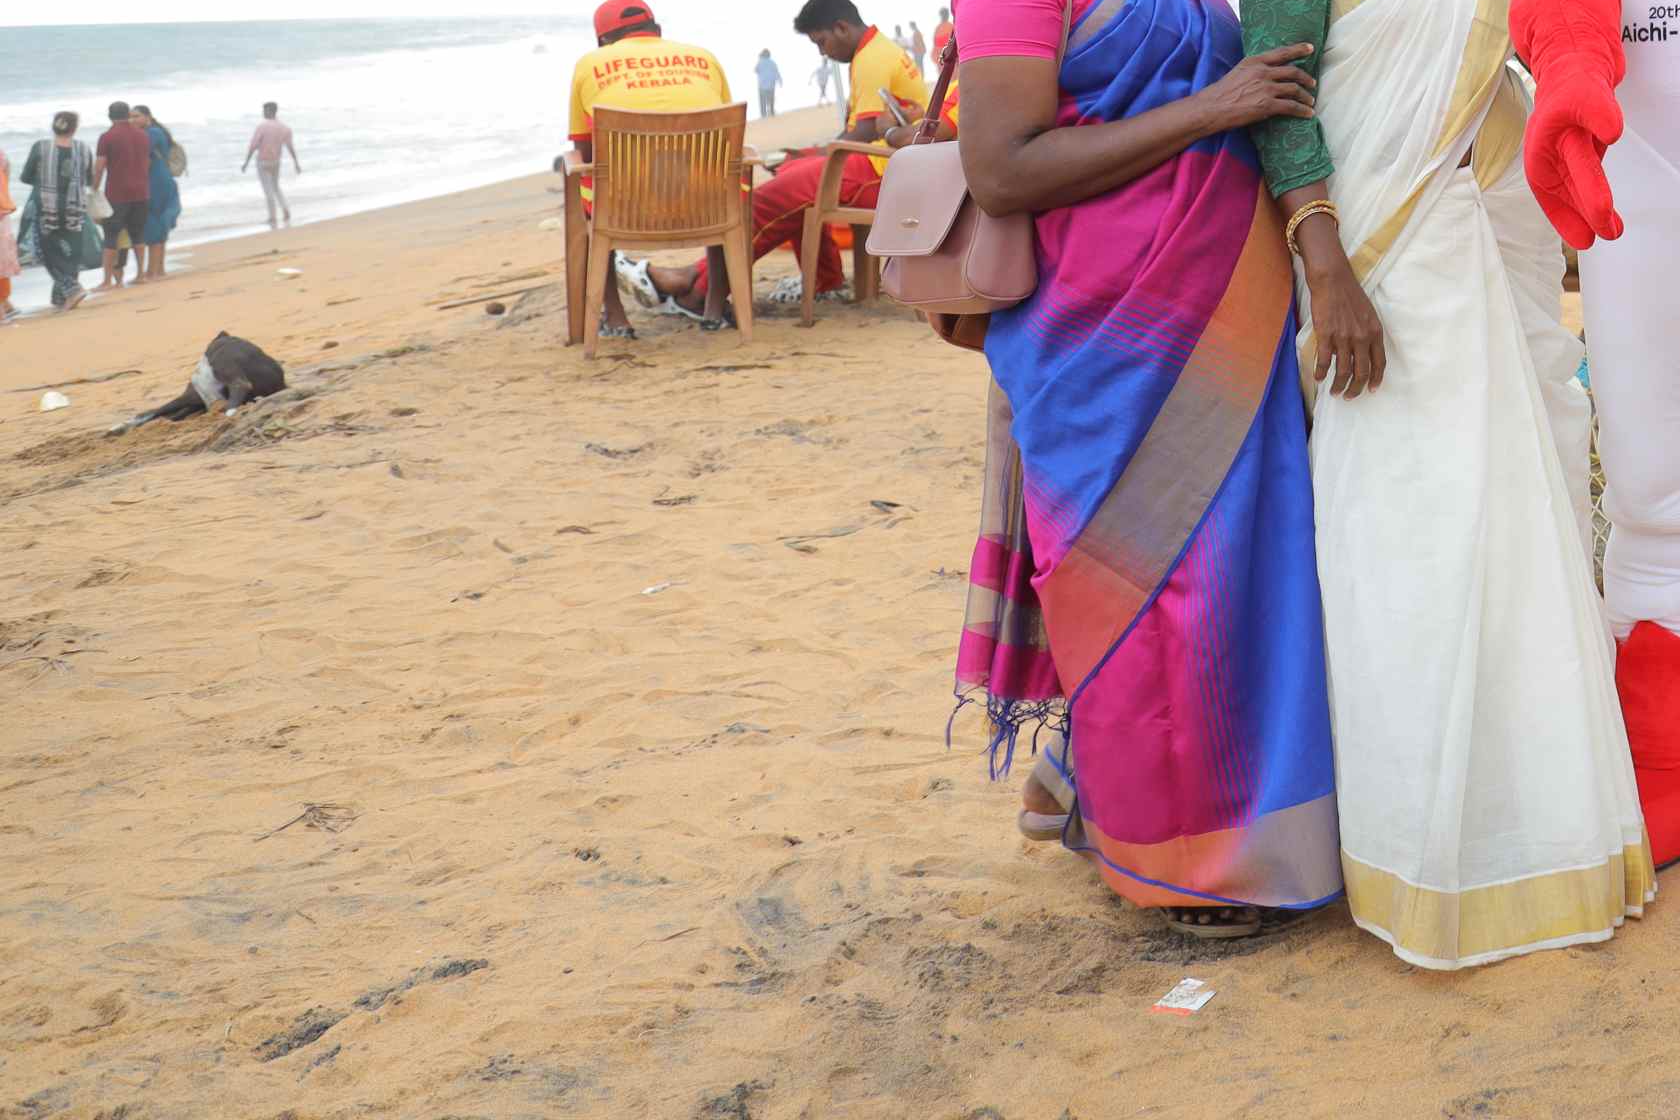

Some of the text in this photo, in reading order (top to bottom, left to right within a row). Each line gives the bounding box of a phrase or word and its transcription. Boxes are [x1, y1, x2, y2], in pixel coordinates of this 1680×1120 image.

[593, 54, 709, 80] LIFEGUARD
[636, 70, 653, 79] OF
[626, 76, 692, 90] KERALA
